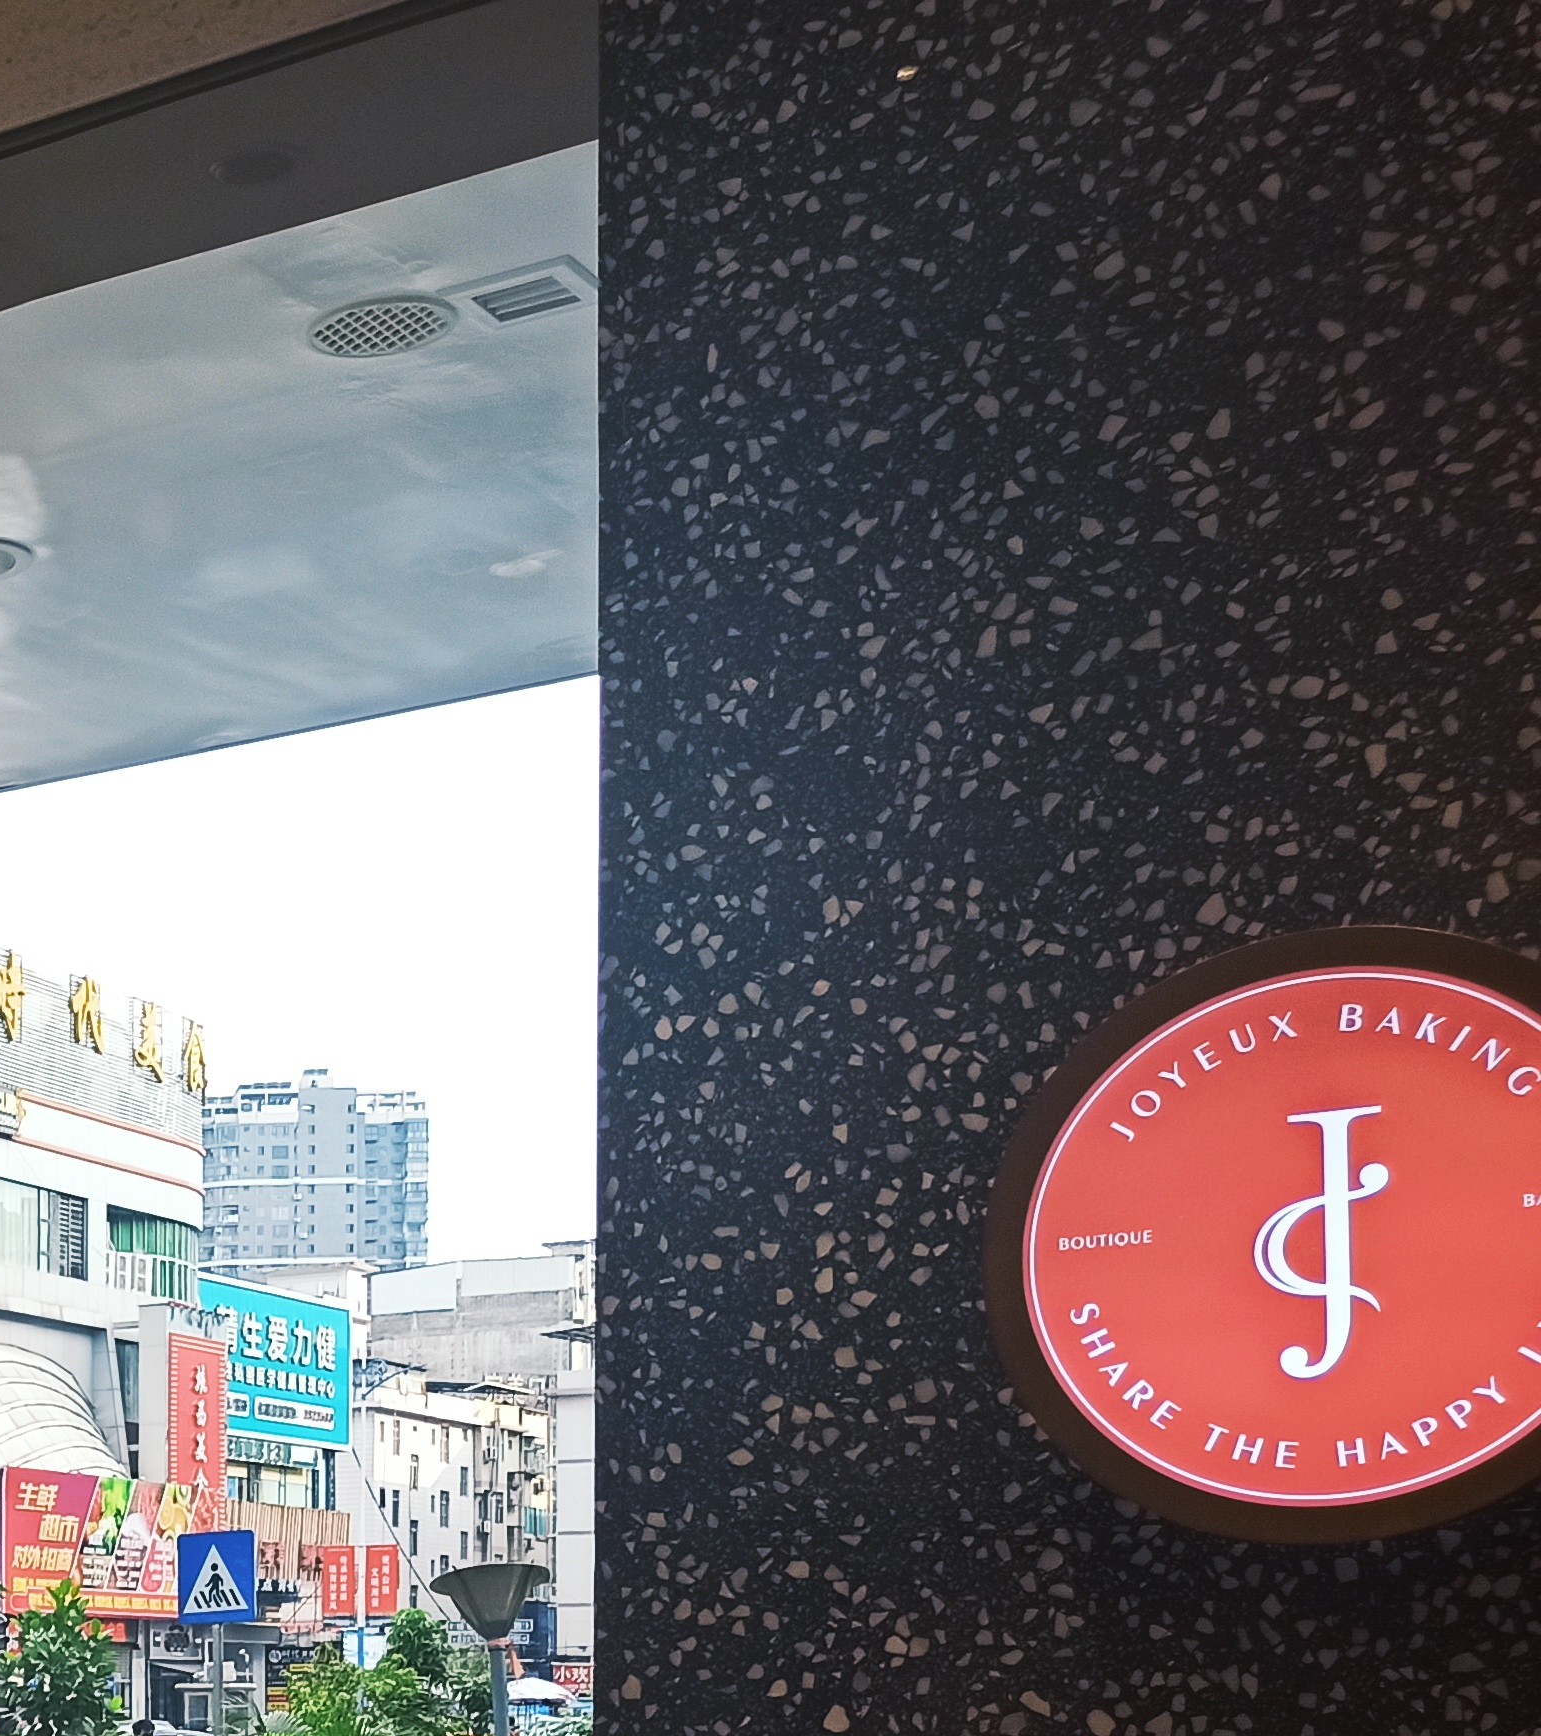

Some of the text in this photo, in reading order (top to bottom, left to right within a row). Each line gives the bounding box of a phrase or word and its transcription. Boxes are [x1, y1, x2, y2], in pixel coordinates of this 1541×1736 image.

[1111, 1003, 1541, 1142] JOYEUX BAKING
[1058, 1229, 1153, 1251] BOUTIQUE
[1070, 1303, 1508, 1470] SHARE THE HAPPY
[15, 1482, 59, 1511] 生鲜
[554, 1666, 594, 1683] 小欢
